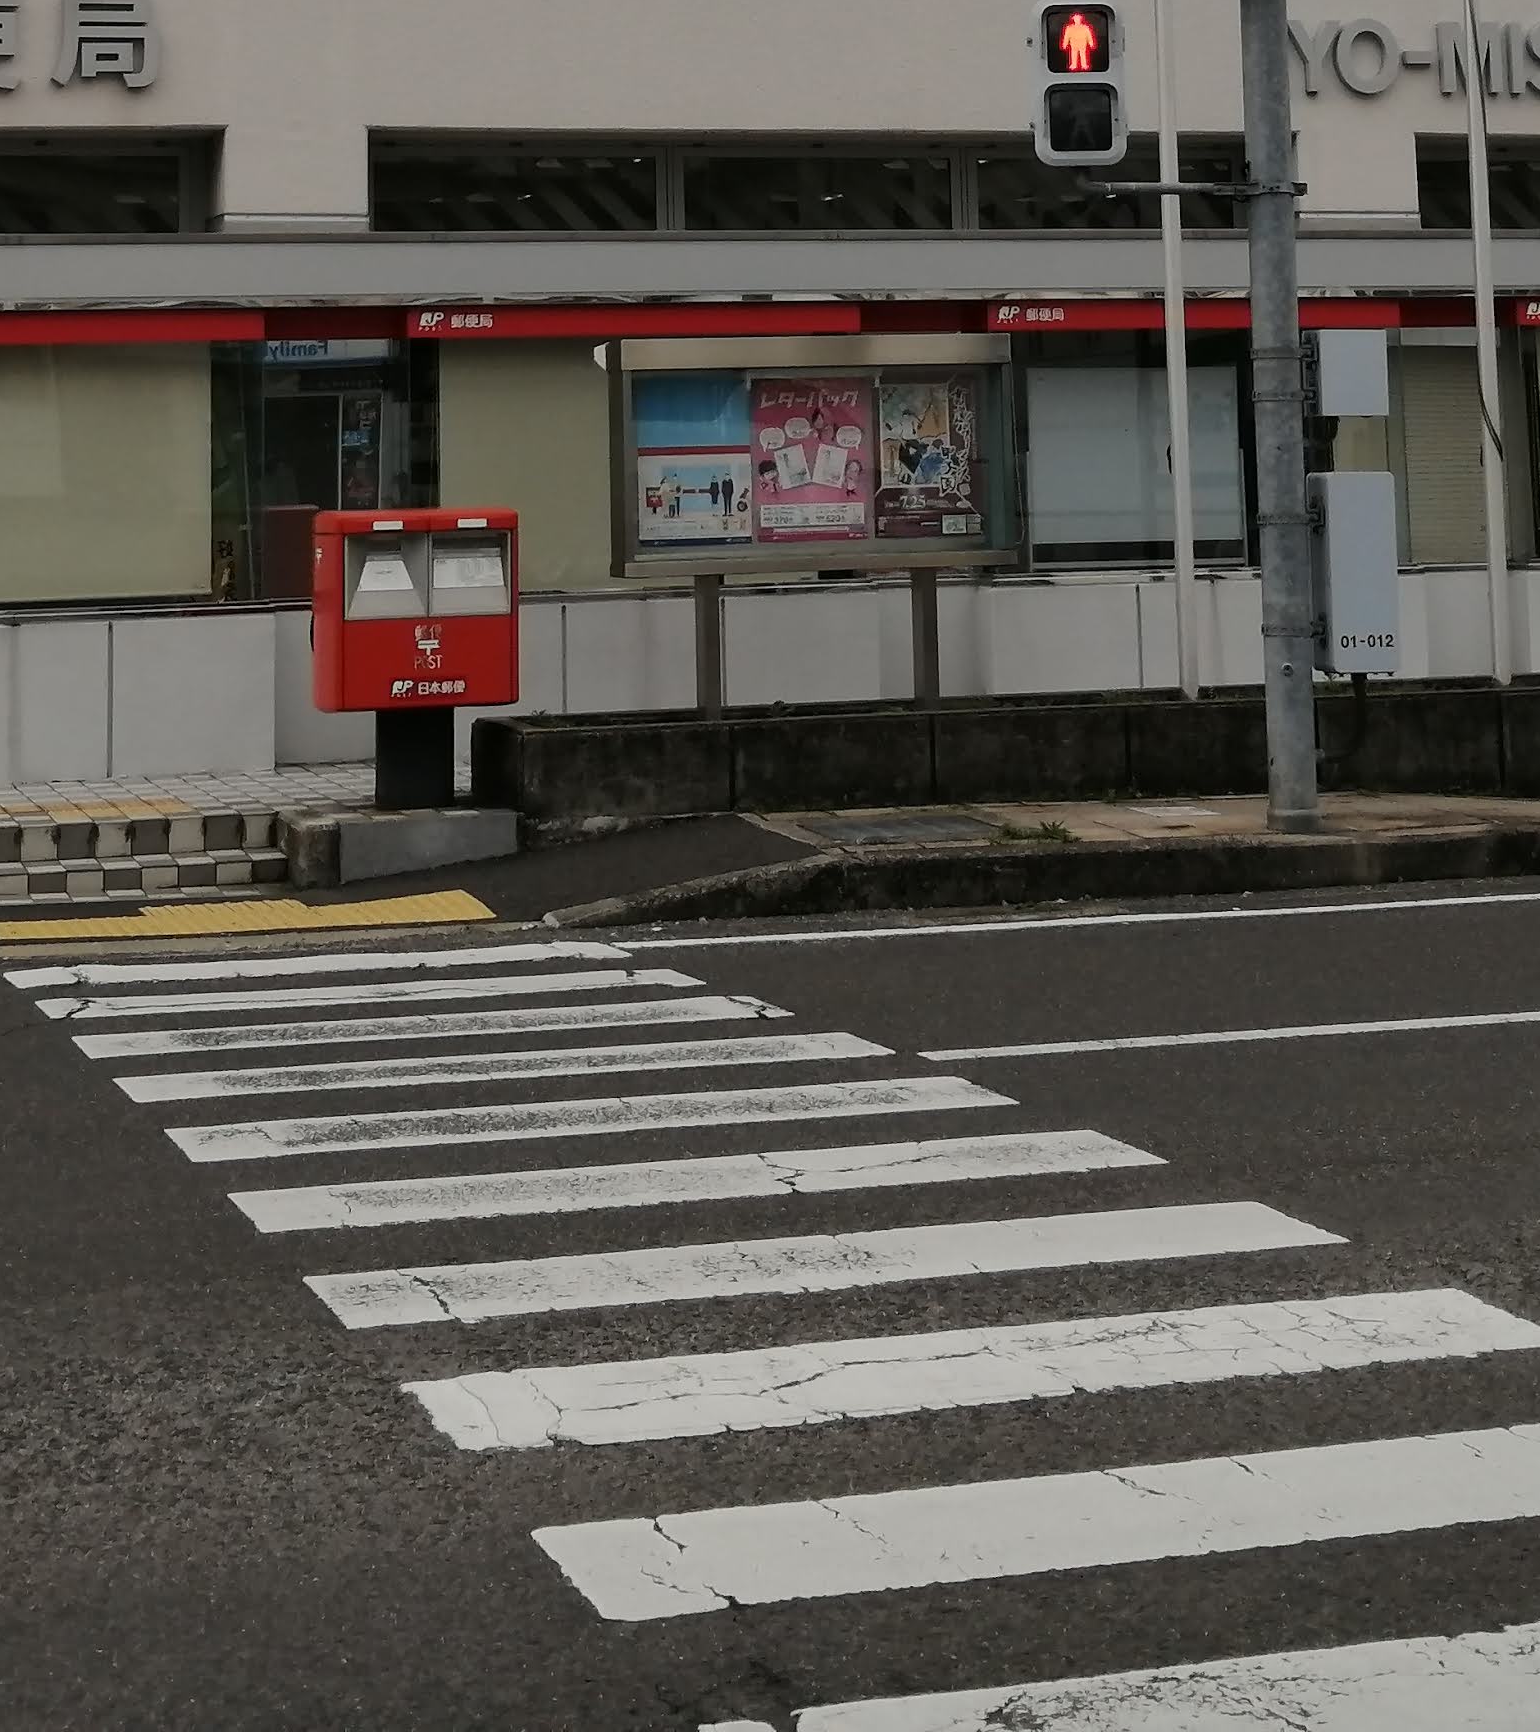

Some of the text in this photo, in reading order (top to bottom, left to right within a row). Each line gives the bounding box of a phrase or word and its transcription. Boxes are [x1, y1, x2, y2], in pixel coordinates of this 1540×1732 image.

[451, 314, 493, 328] 郵便局
[760, 388, 860, 409] レターパック
[1341, 634, 1395, 648] 01-012
[418, 679, 466, 696] 日本郵便
